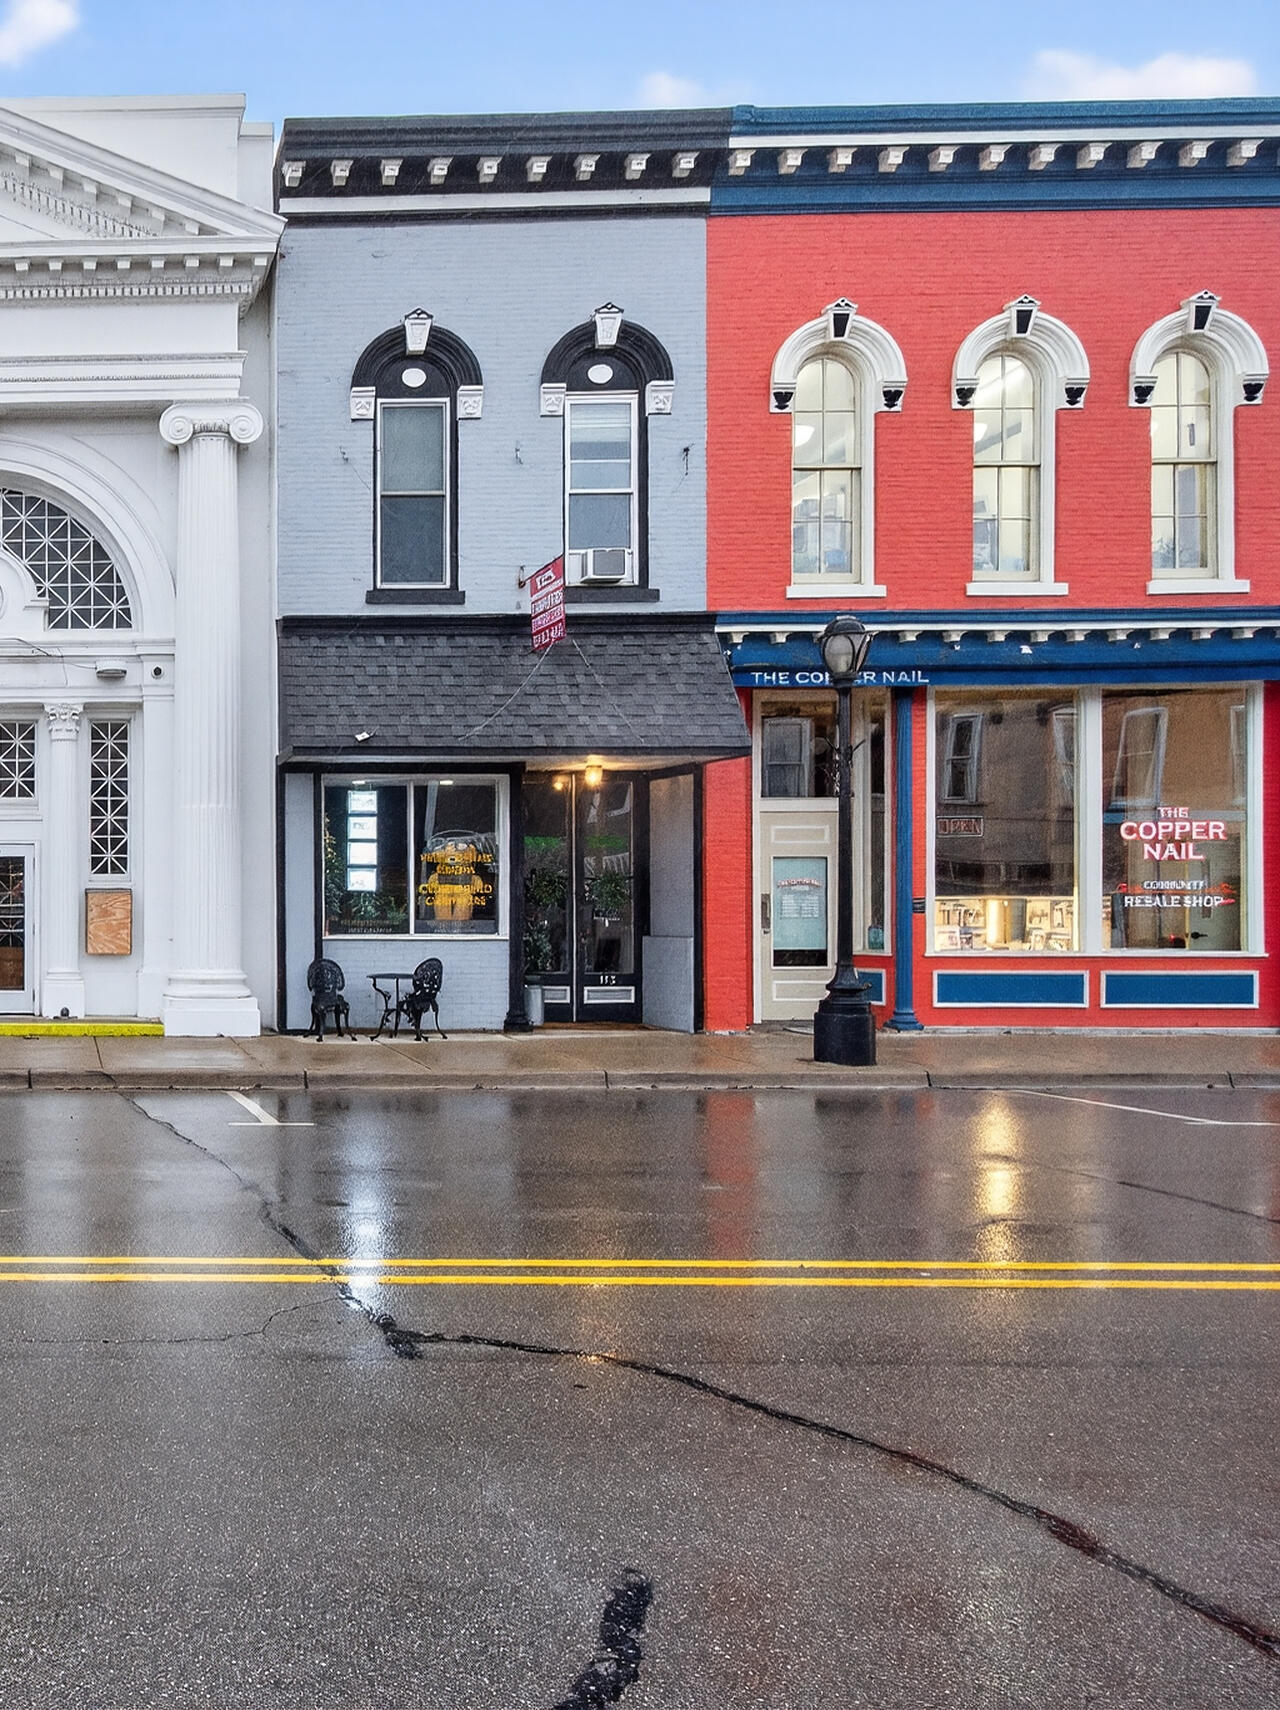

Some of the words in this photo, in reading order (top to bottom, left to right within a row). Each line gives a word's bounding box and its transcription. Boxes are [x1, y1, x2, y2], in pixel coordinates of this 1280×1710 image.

[751, 671, 790, 685] THE
[882, 670, 930, 684] NAIL
[1157, 806, 1189, 818] THE
[1120, 821, 1228, 840] COPPER
[1143, 842, 1205, 861] NAIL
[1124, 895, 1181, 908] RESALE
[1183, 895, 1225, 908] SHOP
